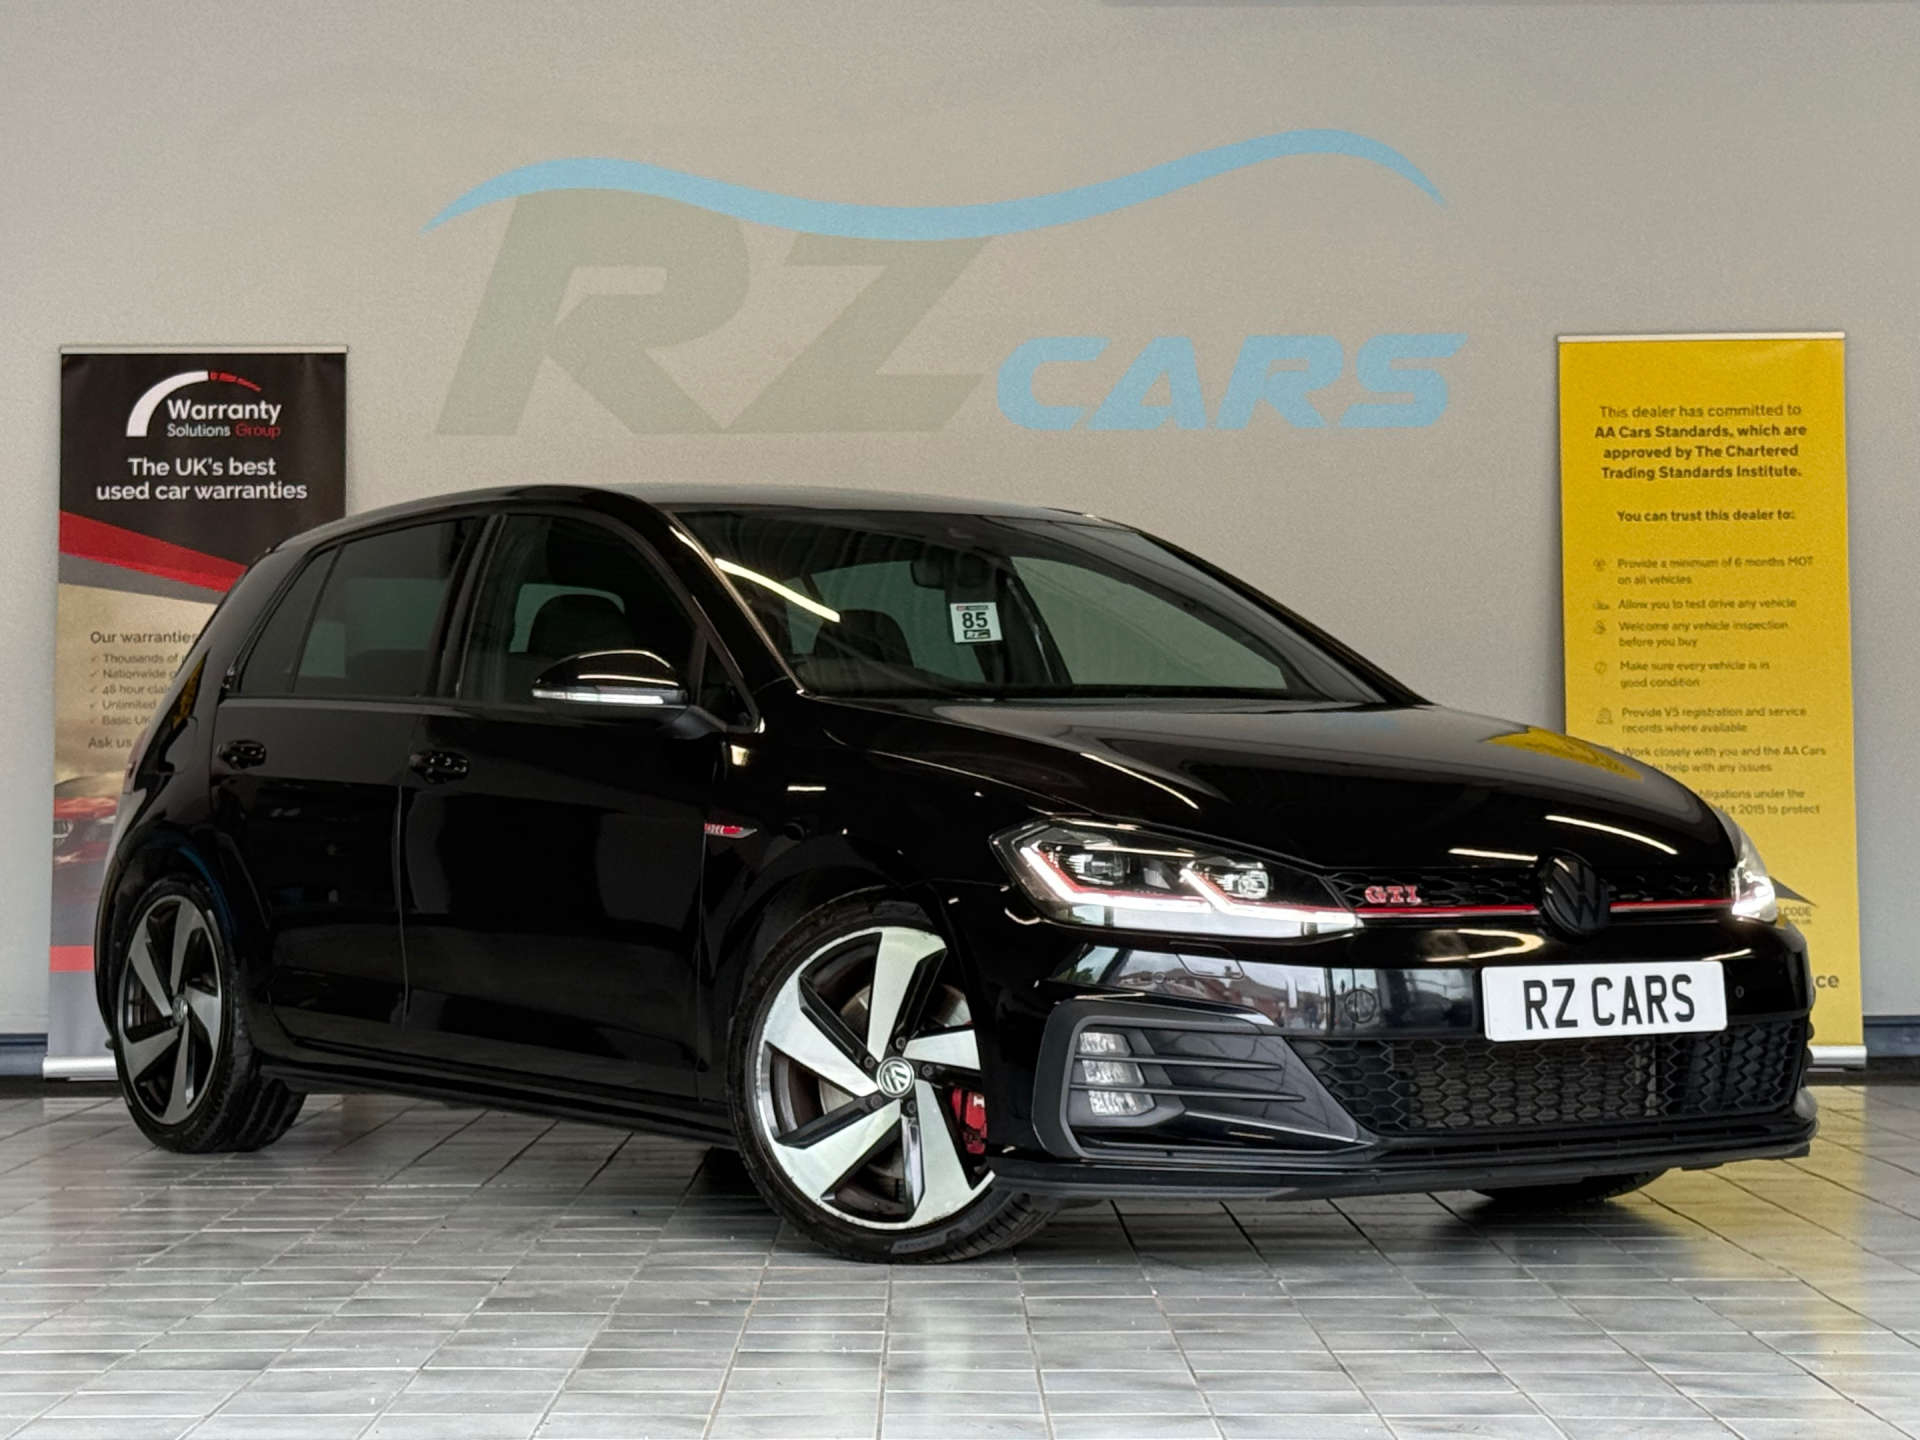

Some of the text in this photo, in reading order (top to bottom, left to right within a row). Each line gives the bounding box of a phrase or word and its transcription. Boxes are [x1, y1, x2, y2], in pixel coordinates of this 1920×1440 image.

[433, 188, 1468, 435] RZ CARS
[167, 399, 282, 426] Warranty
[1600, 405, 1801, 418] This dealer has committed to
[167, 423, 281, 438] Solutions Group
[1595, 424, 1807, 438] AA Cars Standards, which are
[1603, 445, 1798, 460] approved by The Chartered
[128, 457, 277, 476] The UK's best
[1602, 465, 1802, 480] Trading Standards Institute.
[96, 481, 308, 500] used car warranties
[1617, 510, 1641, 522] You
[1644, 513, 1667, 521] can
[1671, 510, 1701, 521] trust
[1705, 509, 1729, 521] this
[1733, 509, 1773, 520] dealer
[1618, 559, 1658, 568] Provide
[1670, 559, 1718, 568] minimum
[1722, 557, 1732, 568] of
[1745, 558, 1785, 567] months
[1788, 556, 1813, 566] MOT
[1634, 575, 1646, 584] all
[1649, 575, 1692, 584] vehicles
[1618, 598, 1797, 612] Allow you to test drive any vehicle
[962, 612, 988, 629] 85
[1618, 620, 1788, 633] Welcome any vehicle inspection
[90, 631, 116, 644] Our
[1619, 637, 1698, 649] before you buy
[103, 653, 164, 665] Thousands
[1620, 661, 1648, 670] Make
[1677, 663, 1706, 673] every
[1708, 660, 1746, 670] vehicle
[1749, 661, 1757, 669] is
[1760, 660, 1770, 669] in
[1620, 677, 1700, 689] good condition
[102, 684, 116, 696] 48
[120, 684, 145, 695] hour
[1622, 708, 1662, 717] Provide
[1682, 707, 1743, 719] registration
[1746, 707, 1764, 716] and
[1768, 708, 1807, 716] service
[1622, 723, 1747, 733] records where available
[88, 736, 112, 749] Ask
[1653, 747, 1690, 758] closely
[1693, 746, 1716, 756] with
[1719, 748, 1738, 758] you
[1741, 746, 1761, 756] and
[1763, 746, 1780, 755] the
[1783, 745, 1799, 755] AA
[1801, 745, 1827, 755] Cars
[1666, 763, 1688, 773] help
[1691, 763, 1716, 772] with
[1718, 765, 1736, 774] any
[1739, 762, 1772, 772] issues
[1754, 788, 1784, 798] under
[1787, 788, 1805, 797] the
[1767, 805, 1778, 813] to
[1781, 804, 1820, 816] protect
[1364, 885, 1422, 904] GTI
[1523, 973, 1695, 1030] RZ CARS
